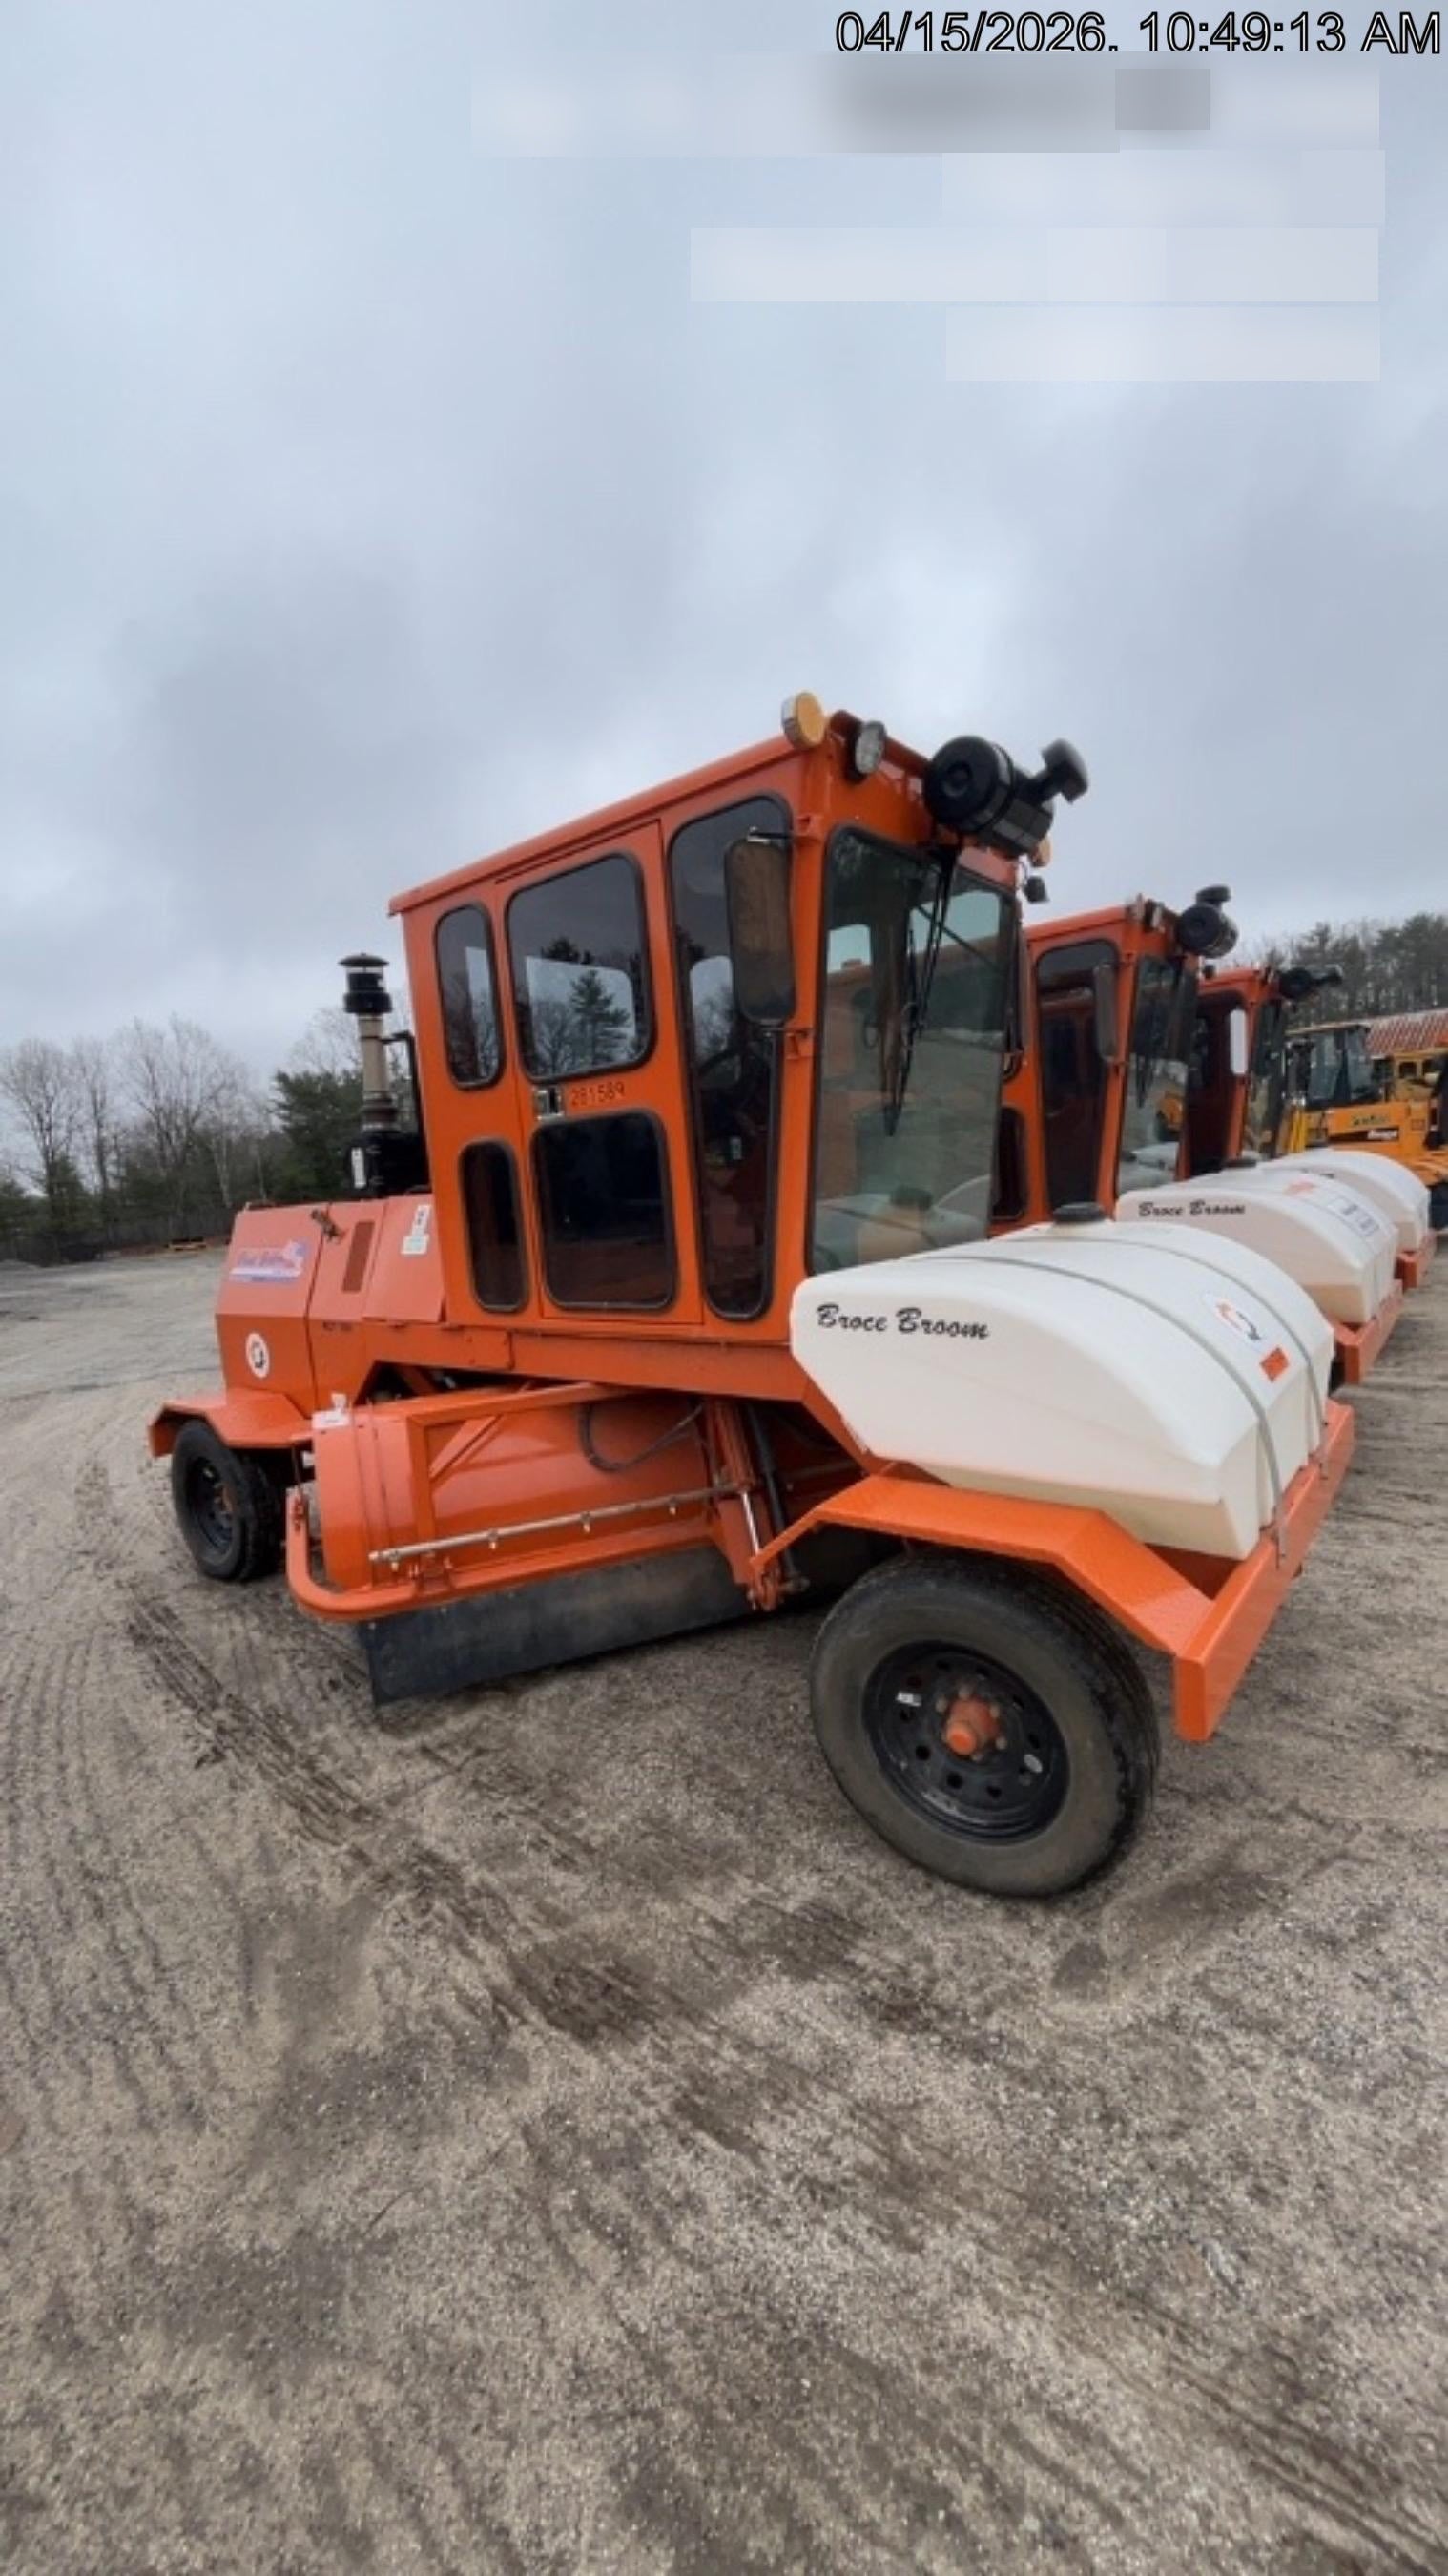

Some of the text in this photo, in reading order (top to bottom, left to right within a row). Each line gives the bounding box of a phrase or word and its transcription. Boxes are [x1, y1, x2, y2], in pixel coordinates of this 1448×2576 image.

[572, 1081, 625, 1107] 281589
[817, 1303, 990, 1340] Broce Broom
